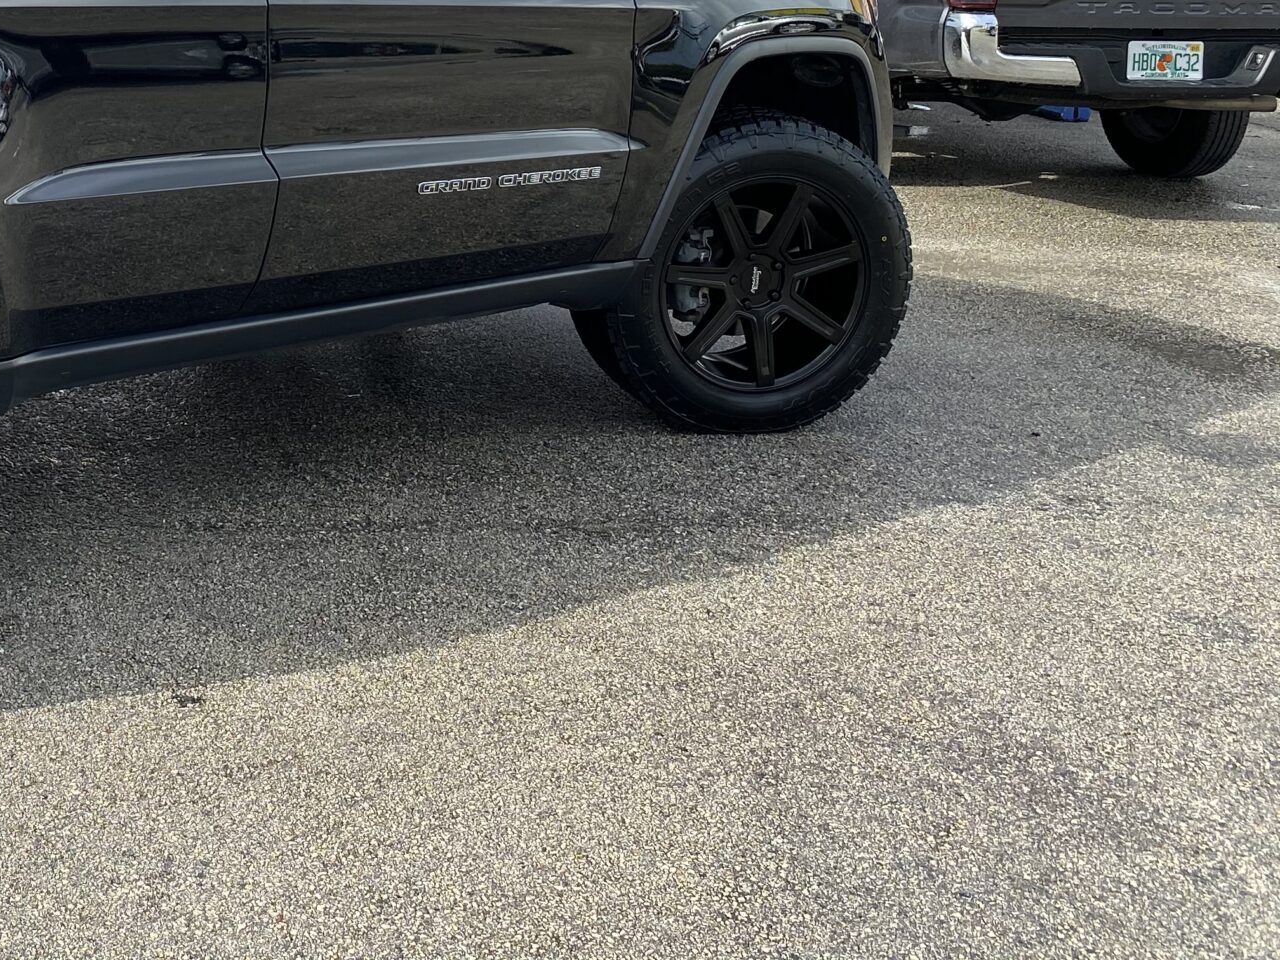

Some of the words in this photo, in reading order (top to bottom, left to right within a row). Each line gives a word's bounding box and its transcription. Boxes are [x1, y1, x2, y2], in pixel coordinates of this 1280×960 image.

[1077, 1, 1280, 16] TACOMA
[1174, 52, 1200, 71] C32
[417, 176, 492, 195] GRAND
[497, 166, 602, 187] CHEROKEE
